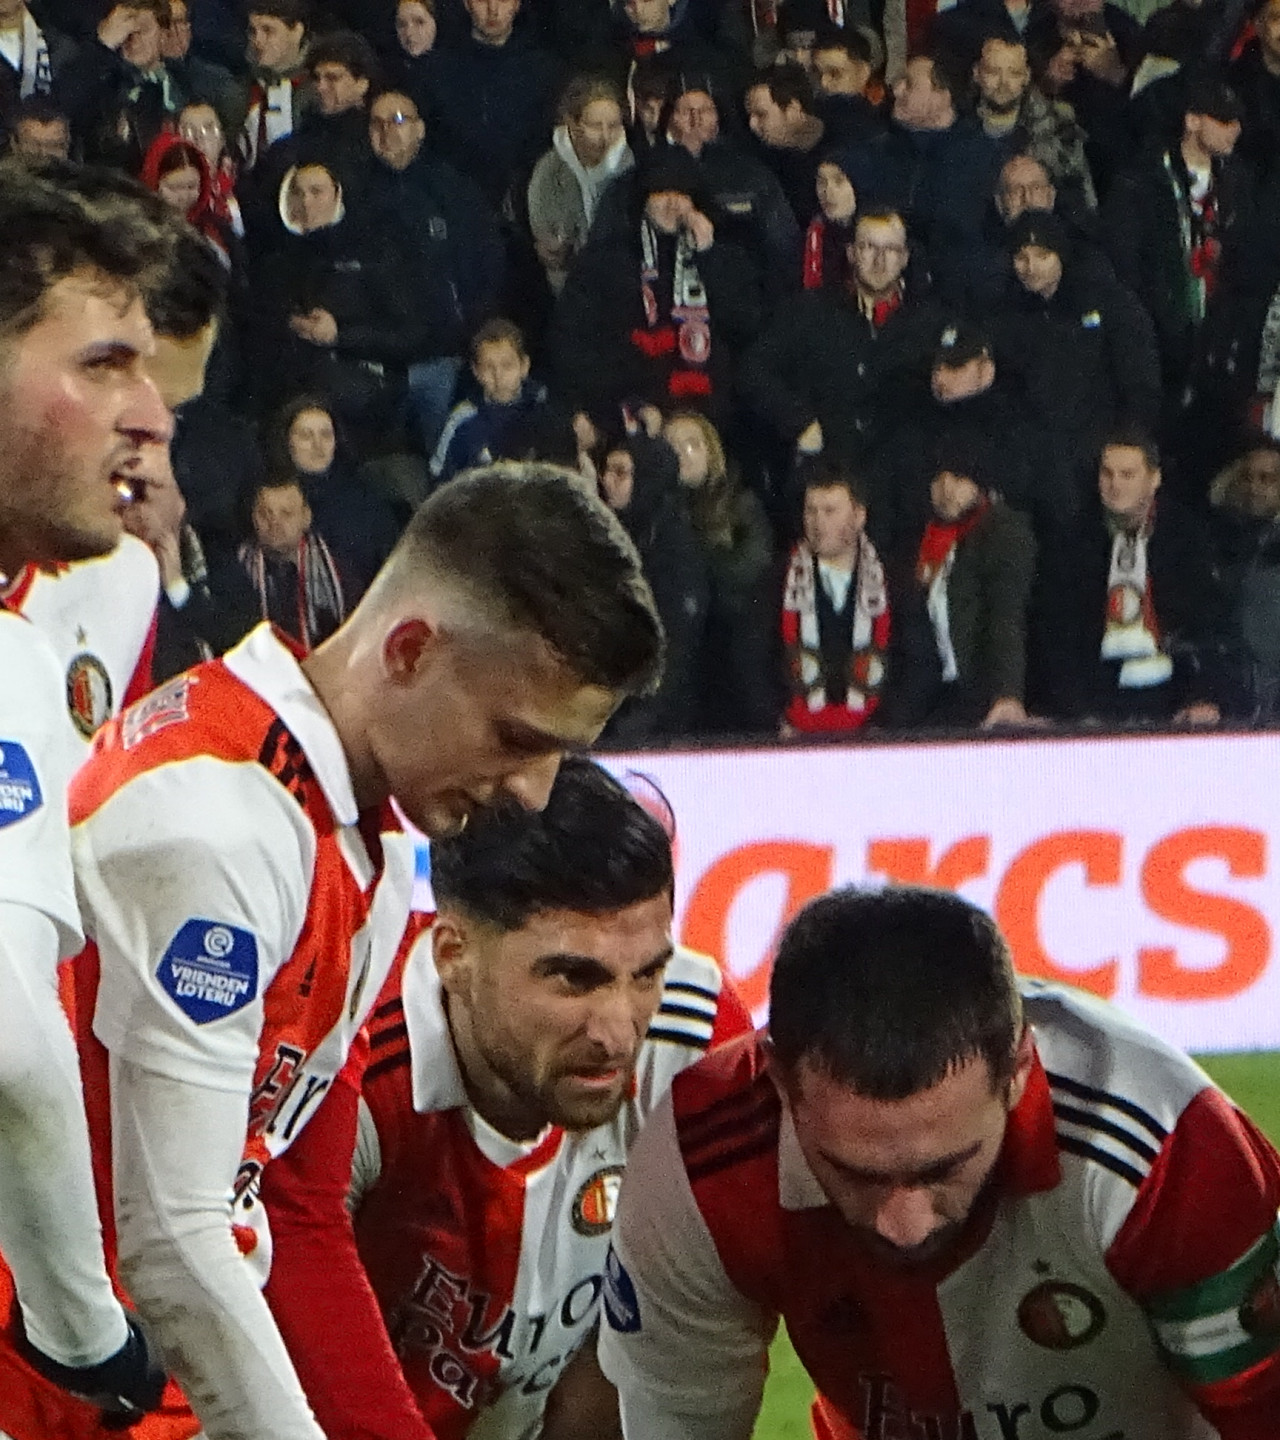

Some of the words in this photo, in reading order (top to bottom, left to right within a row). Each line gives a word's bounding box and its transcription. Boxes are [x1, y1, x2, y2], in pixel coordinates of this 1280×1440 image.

[666, 822, 1274, 1012] arcs
[170, 963, 250, 995] VRIENDEN
[176, 981, 237, 1007] LOTERIJ
